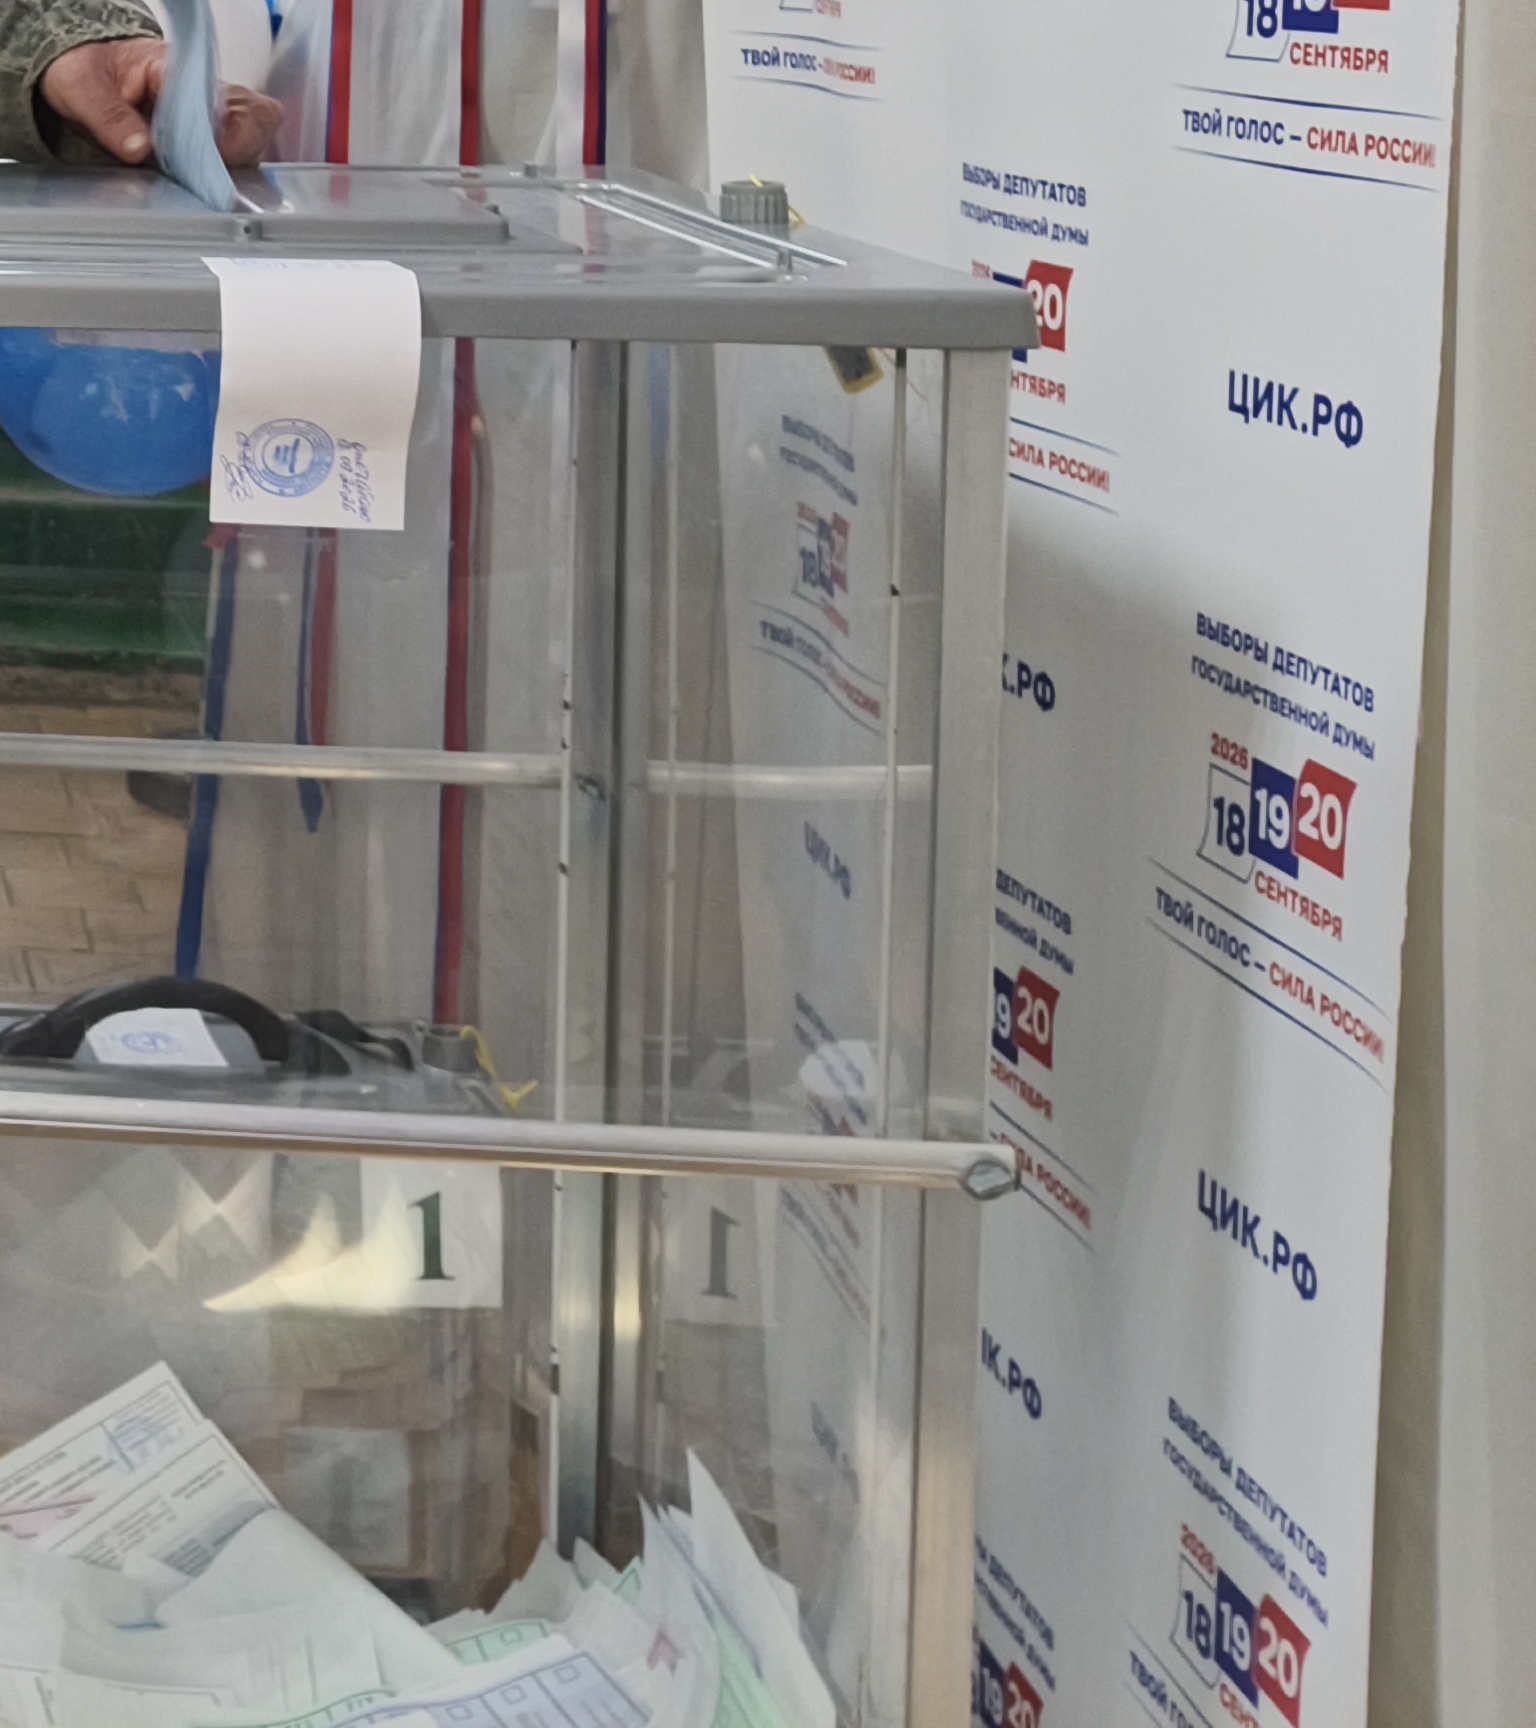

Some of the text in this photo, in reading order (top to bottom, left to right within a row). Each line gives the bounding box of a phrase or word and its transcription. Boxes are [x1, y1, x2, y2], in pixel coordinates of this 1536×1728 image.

[741, 45, 780, 67] ТВОЙ
[1290, 42, 1389, 73] СЕНТЯБРЯ
[1183, 109, 1222, 136] ТВОЙ
[1227, 116, 1285, 145] ГОЛОС
[1307, 127, 1358, 156] СИЛА
[1003, 173, 1086, 207] ДЕПУТАТОВ
[1051, 223, 1089, 247] ДУМЫ
[1028, 279, 1063, 331] 20
[1011, 370, 1065, 405] НТЯБРЯ
[1227, 369, 1364, 449] ЦИК.РФ
[1009, 437, 1045, 468] СИЛА
[1196, 612, 1375, 712] ВЫБОРЫ ДЕПУТАТОВ
[1191, 654, 1375, 761] ГОСУДАРСТВЕННОЙ ДУМЫ
[1211, 733, 1248, 770] 2026
[1213, 782, 1343, 856] 18 19 20
[1255, 870, 1342, 941] СЕНТЯБРЯ
[1155, 886, 1194, 933] ТВОЙ
[1197, 917, 1251, 968] ГОЛОС
[1269, 961, 1316, 1011] СИЛА
[994, 986, 1049, 1045] 9 20
[408, 1191, 455, 1280] 1
[1198, 1169, 1317, 1300] ЦИК.РФ
[981, 1327, 1042, 1419] К.РФ
[1168, 1396, 1327, 1578] ВЫБОРЫ ДЕПУТАТОВ
[1184, 1590, 1298, 1698] 18 19 20
[982, 1667, 1035, 1728] 19 20
